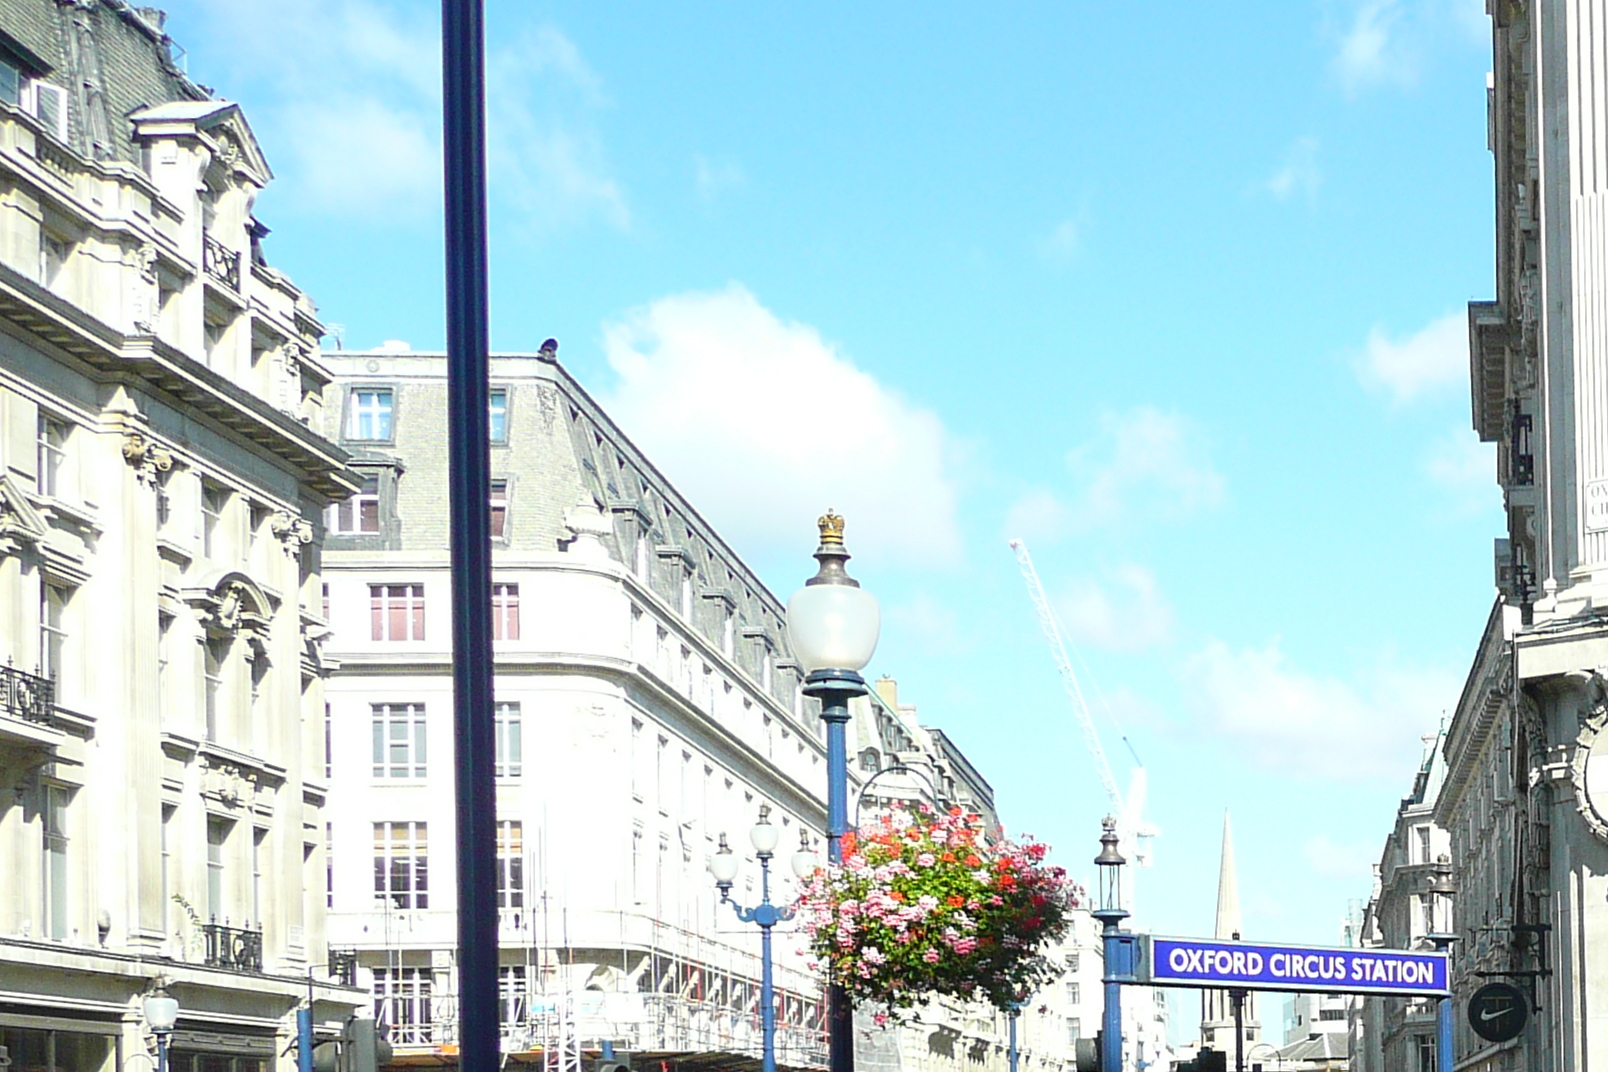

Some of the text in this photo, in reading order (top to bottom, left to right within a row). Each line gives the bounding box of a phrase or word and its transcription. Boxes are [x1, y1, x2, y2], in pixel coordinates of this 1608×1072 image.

[1169, 948, 1434, 984] OXFORD CIRCUS STATION
